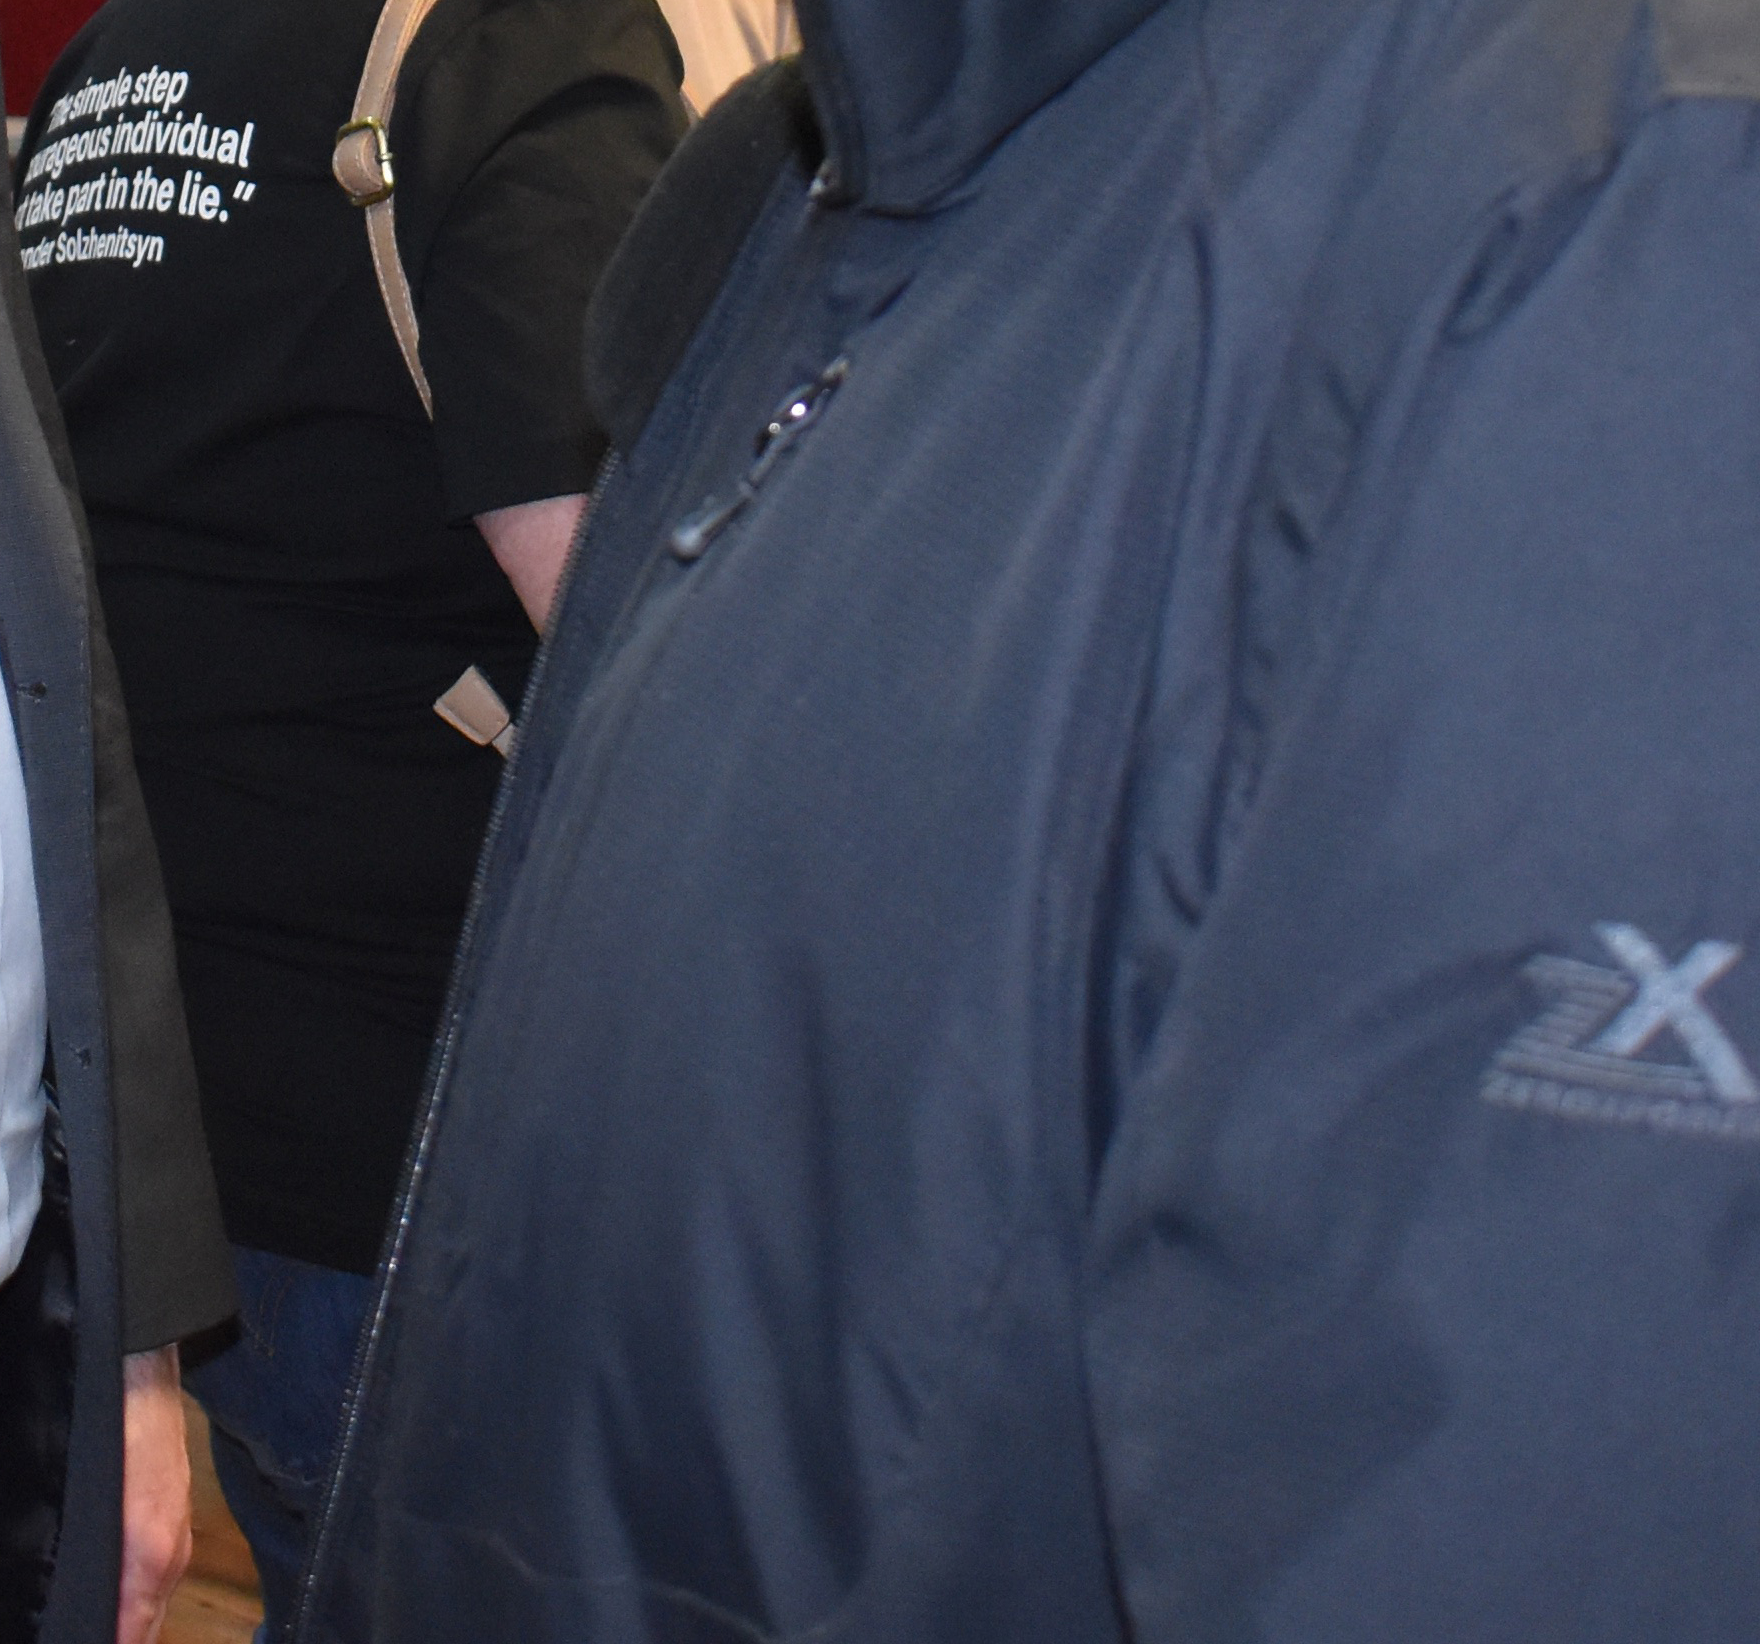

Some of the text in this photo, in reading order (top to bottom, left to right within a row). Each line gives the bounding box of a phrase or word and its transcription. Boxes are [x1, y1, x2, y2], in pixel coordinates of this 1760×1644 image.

[70, 66, 133, 122] simple
[131, 65, 189, 114] step
[110, 110, 255, 168] individual
[61, 172, 107, 227] part
[105, 167, 128, 210] in
[130, 165, 175, 212] the
[55, 225, 164, 268] Solzhenitsyn
